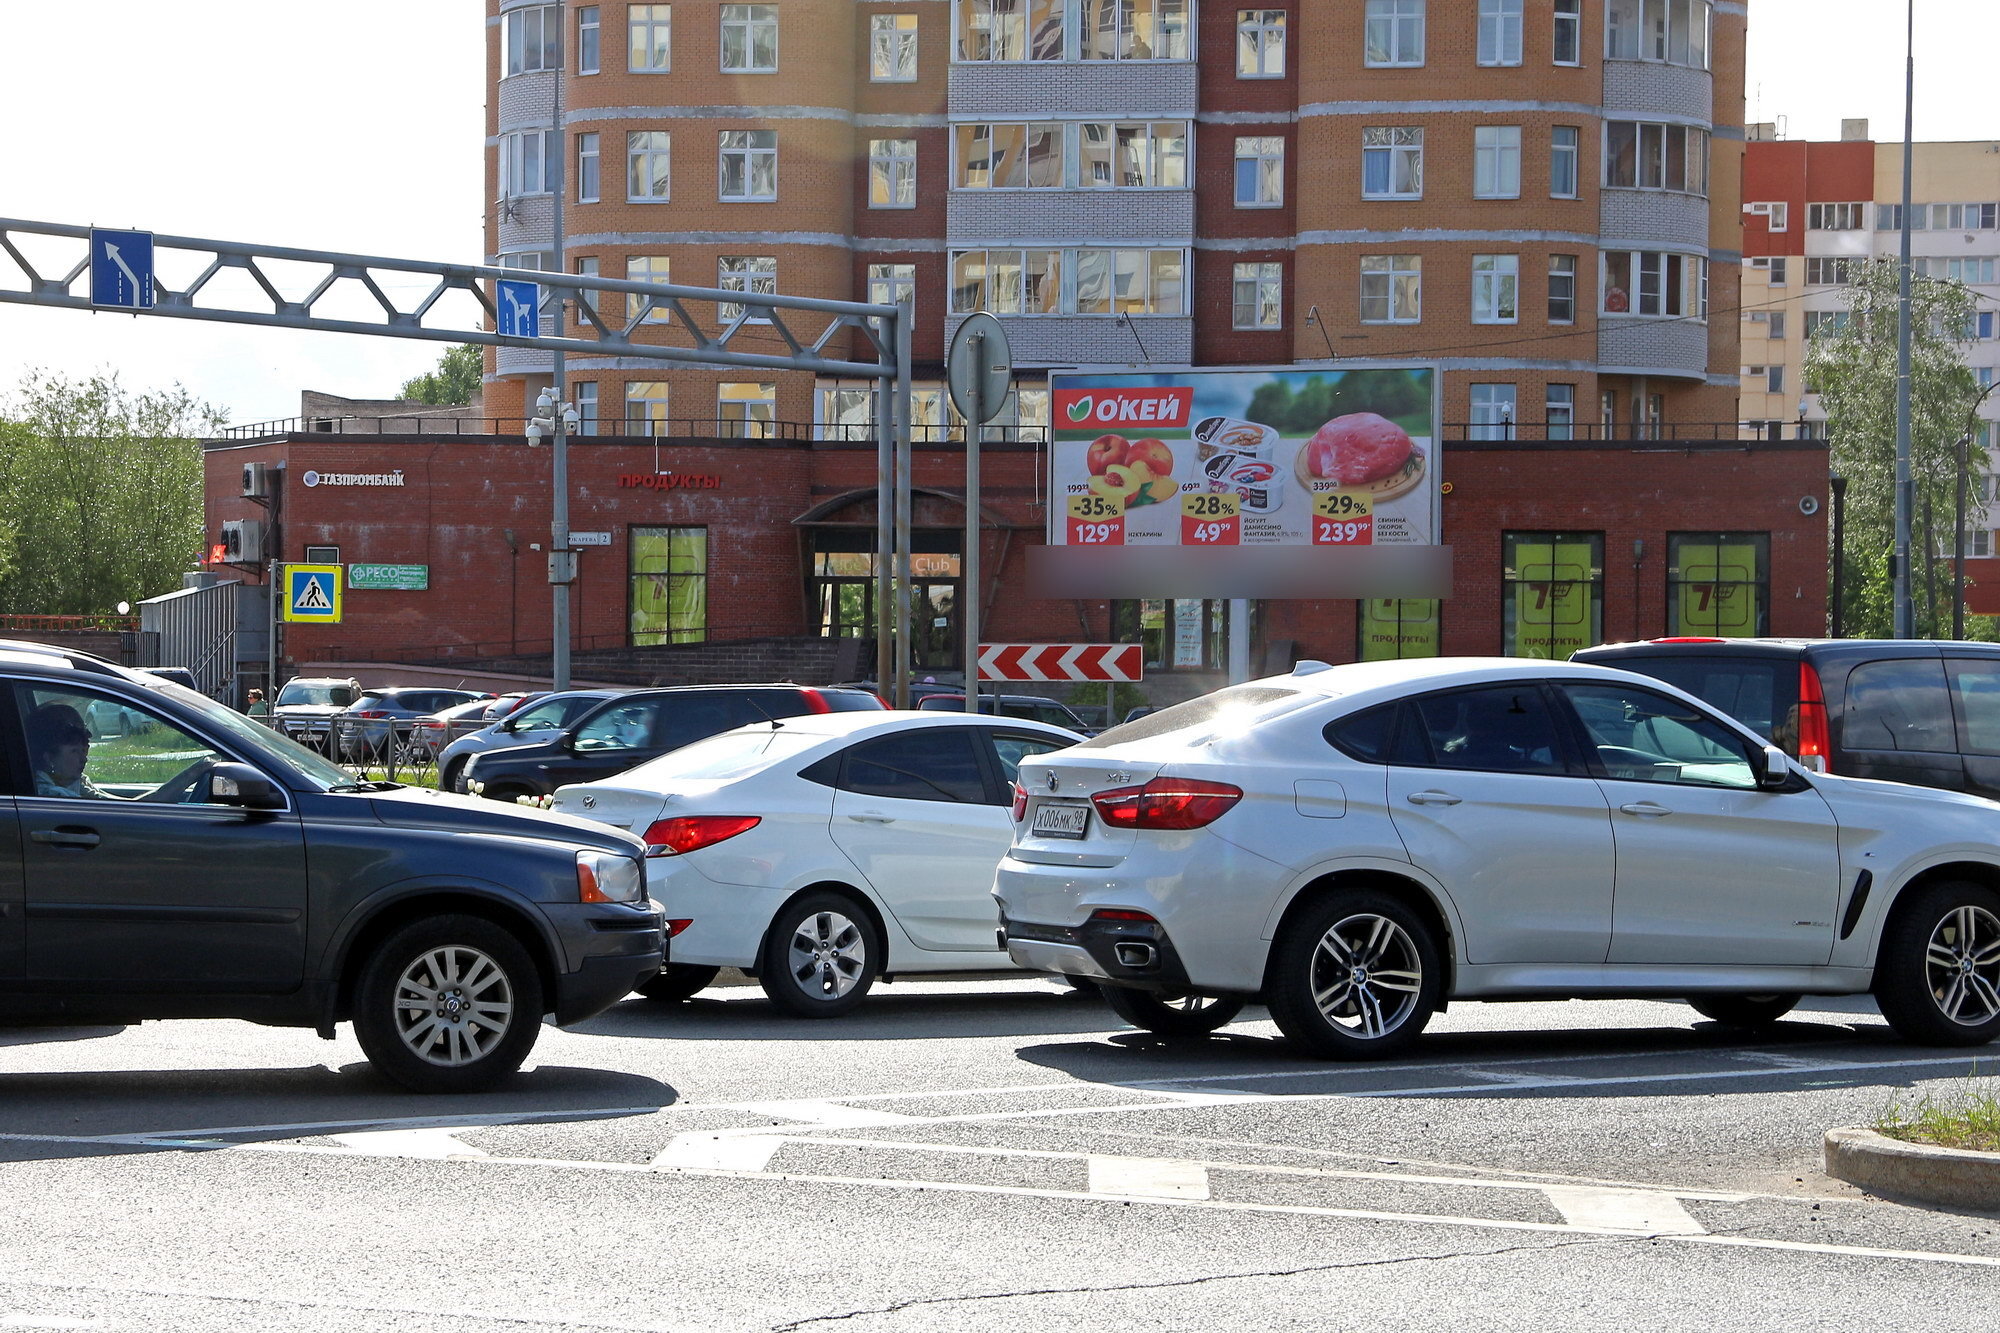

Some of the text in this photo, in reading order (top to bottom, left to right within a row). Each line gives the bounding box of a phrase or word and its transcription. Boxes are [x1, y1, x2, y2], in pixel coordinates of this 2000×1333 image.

[322, 472, 405, 486] ГАЗПРОМБАНК
[617, 474, 720, 491] ПРОДУКТЫ
[1074, 498, 1118, 515] -35%
[1187, 496, 1234, 515] -28%
[1320, 496, 1367, 514] -29%
[602, 534, 607, 543] 2
[366, 567, 399, 578] РЕСО
[915, 558, 950, 572] Club
[1692, 584, 1713, 612] 7
